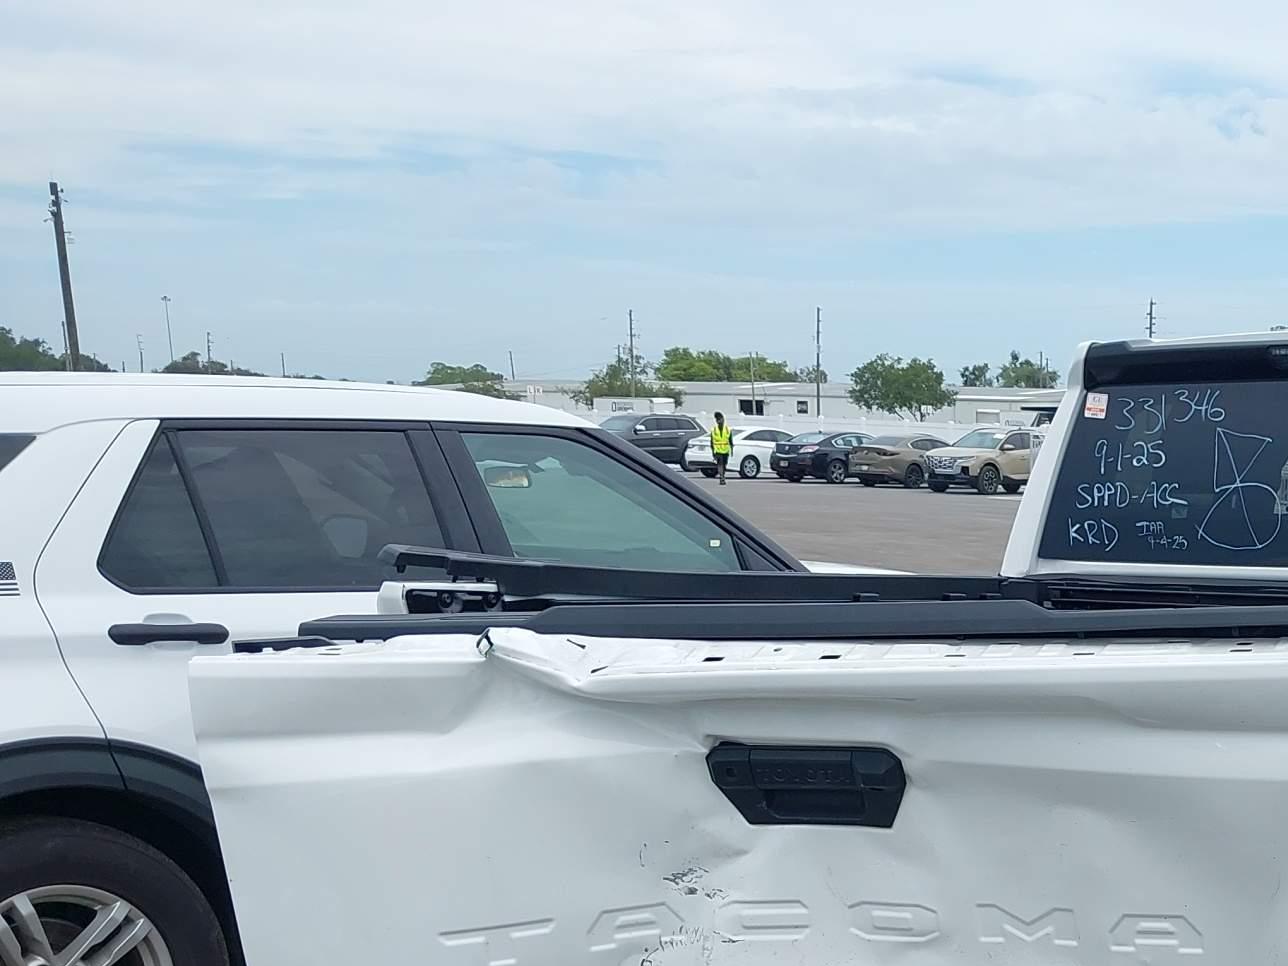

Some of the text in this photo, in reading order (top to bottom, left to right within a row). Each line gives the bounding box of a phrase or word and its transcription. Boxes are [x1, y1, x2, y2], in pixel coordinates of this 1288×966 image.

[1094, 439, 1166, 475] 9-1-25
[1076, 481, 1188, 509] SPPD-ACC
[1068, 517, 1119, 552] KRD
